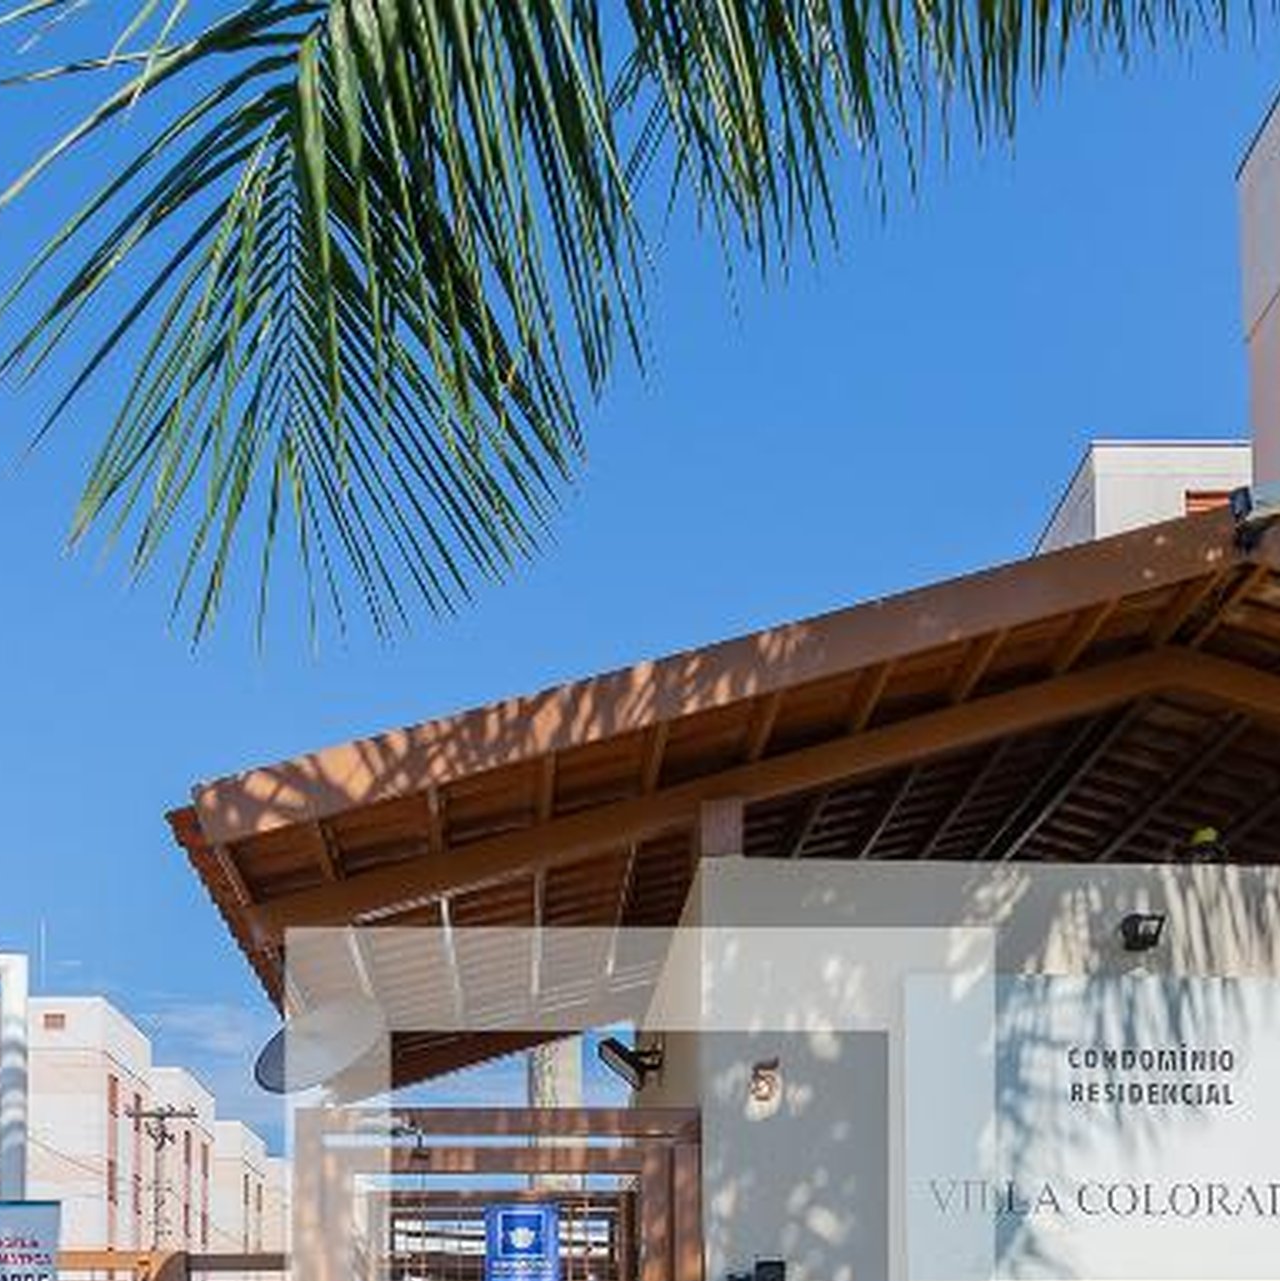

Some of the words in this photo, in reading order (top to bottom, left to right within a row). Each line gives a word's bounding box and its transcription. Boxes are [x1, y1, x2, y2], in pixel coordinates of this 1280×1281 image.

[1067, 1042, 1235, 1072] CONDOMÍNIO
[747, 1055, 780, 1102] 5
[1070, 1082, 1235, 1106] RESIDENCIAL
[929, 1179, 1063, 1216] VILLA
